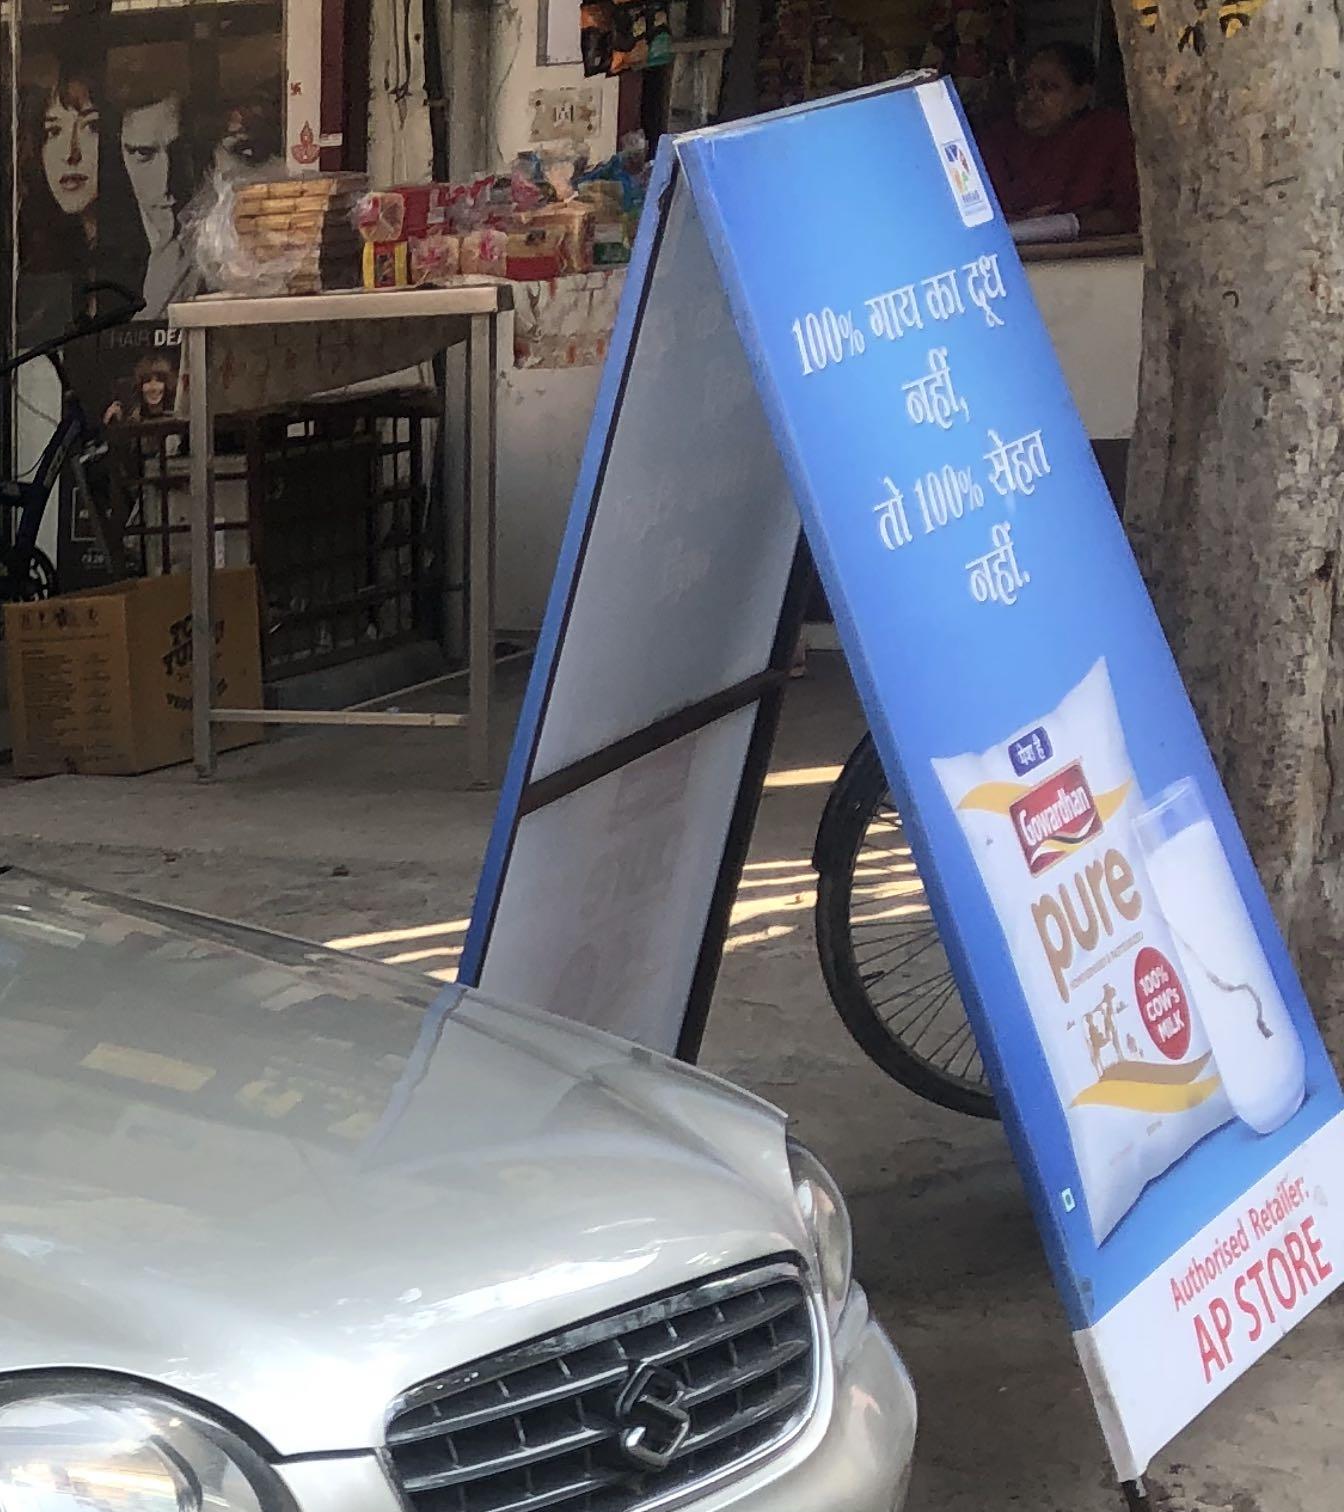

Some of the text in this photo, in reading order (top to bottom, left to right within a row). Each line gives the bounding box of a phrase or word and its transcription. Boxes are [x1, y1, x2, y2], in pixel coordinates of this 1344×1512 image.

[792, 254, 1007, 376] 100% गाय का दूध
[872, 428, 1051, 551] तो 100% सेहत
[1019, 786, 1092, 846] Gowardhan
[1030, 848, 1143, 1004] pure
[1139, 965, 1170, 997] 100%
[1157, 1009, 1185, 1043] MILK
[1170, 1218, 1250, 1312] Authorised
[1193, 1215, 1333, 1384] AP STORE
